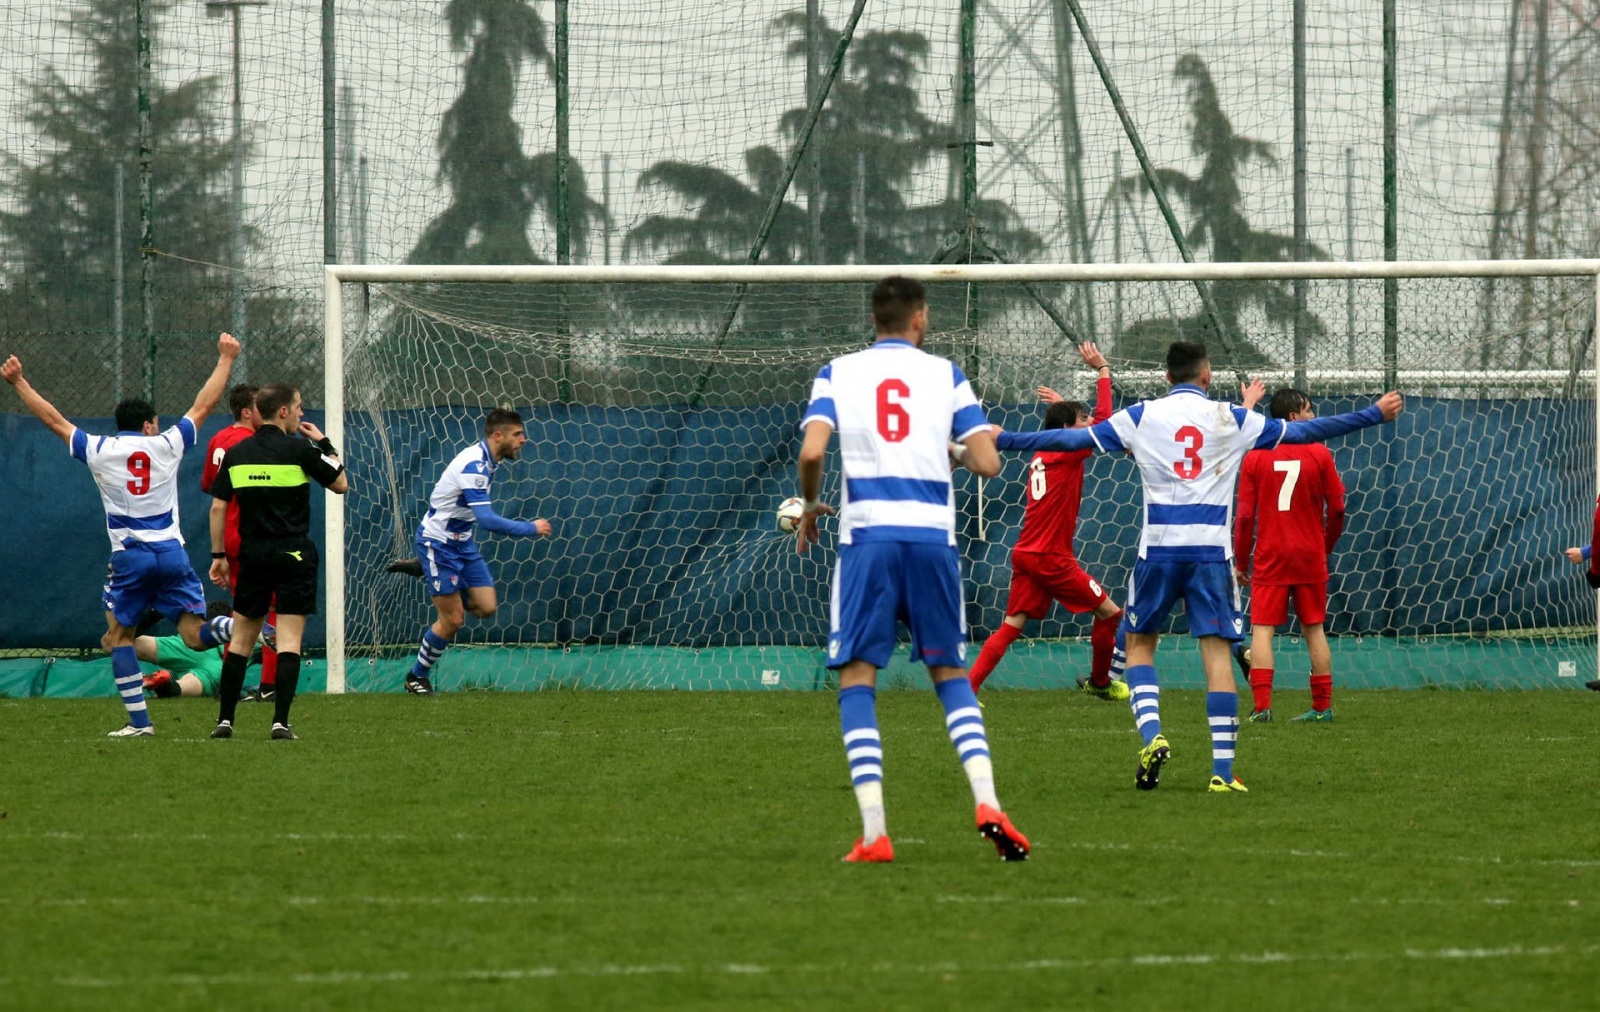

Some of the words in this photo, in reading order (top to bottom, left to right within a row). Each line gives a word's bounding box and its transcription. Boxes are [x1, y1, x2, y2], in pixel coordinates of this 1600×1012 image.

[876, 378, 911, 443] 6
[126, 451, 151, 495] 9
[1173, 425, 1204, 480] 3
[1273, 459, 1301, 512] 7
